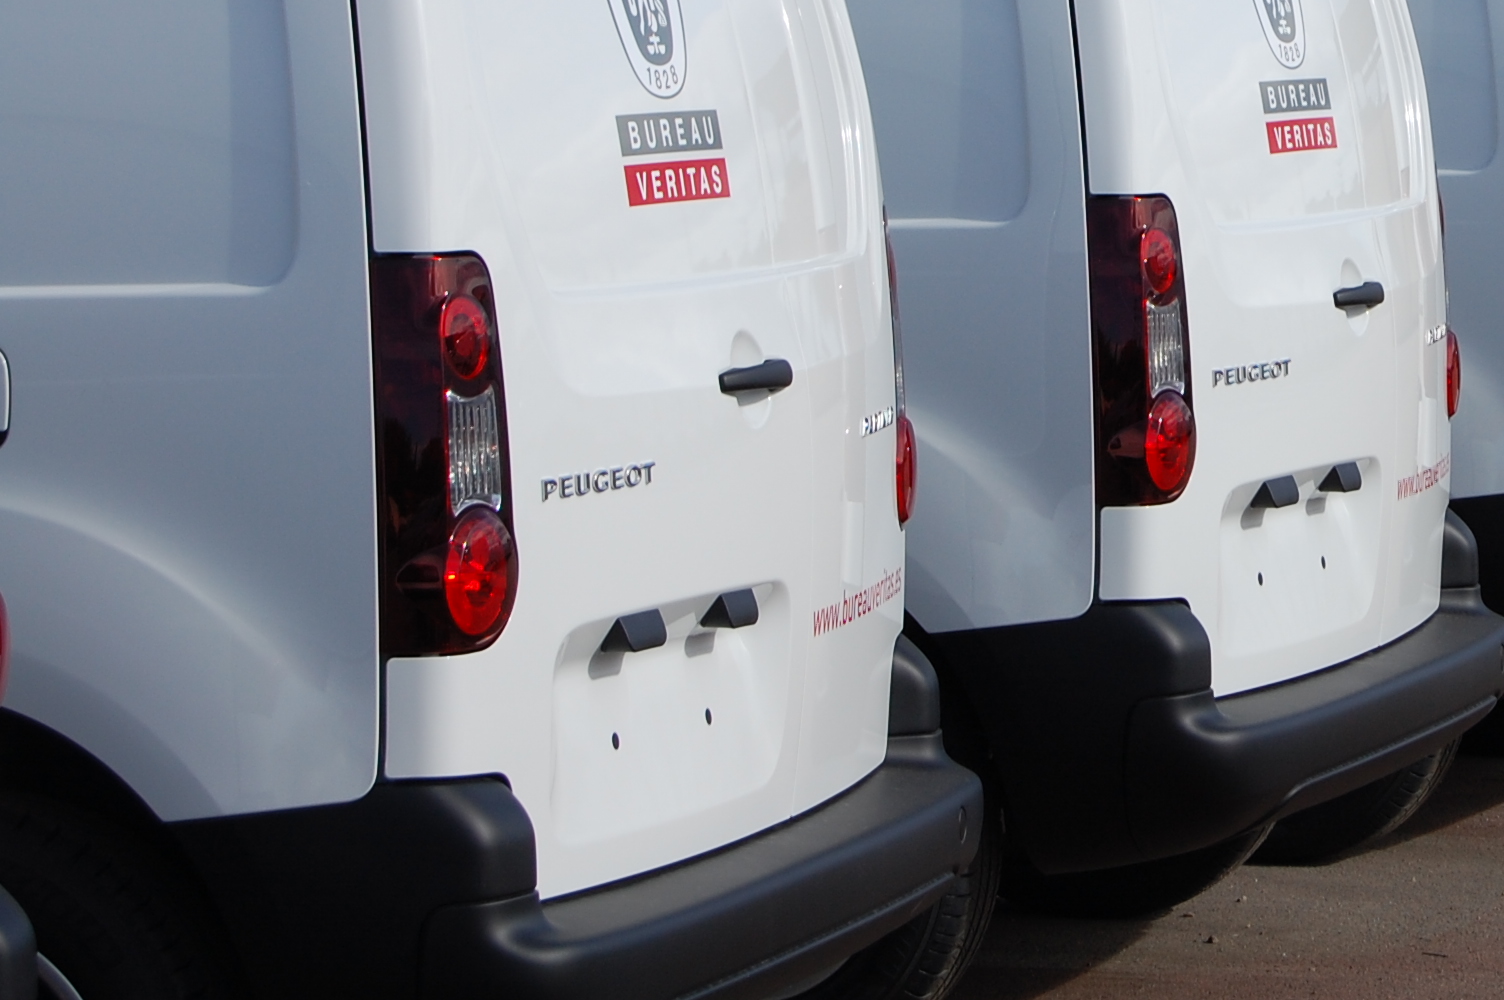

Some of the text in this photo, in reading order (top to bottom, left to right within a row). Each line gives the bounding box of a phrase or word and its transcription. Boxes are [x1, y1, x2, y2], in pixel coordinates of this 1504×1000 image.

[1278, 42, 1301, 63] 1828
[646, 64, 679, 90] 1828
[1266, 82, 1327, 110] BUREAU
[627, 115, 715, 150] BUREAU
[1273, 121, 1333, 150] VERITAS
[636, 164, 723, 202] VERITAS
[1212, 359, 1292, 388] PEUGEOT
[541, 461, 656, 502] PEUGEOT
